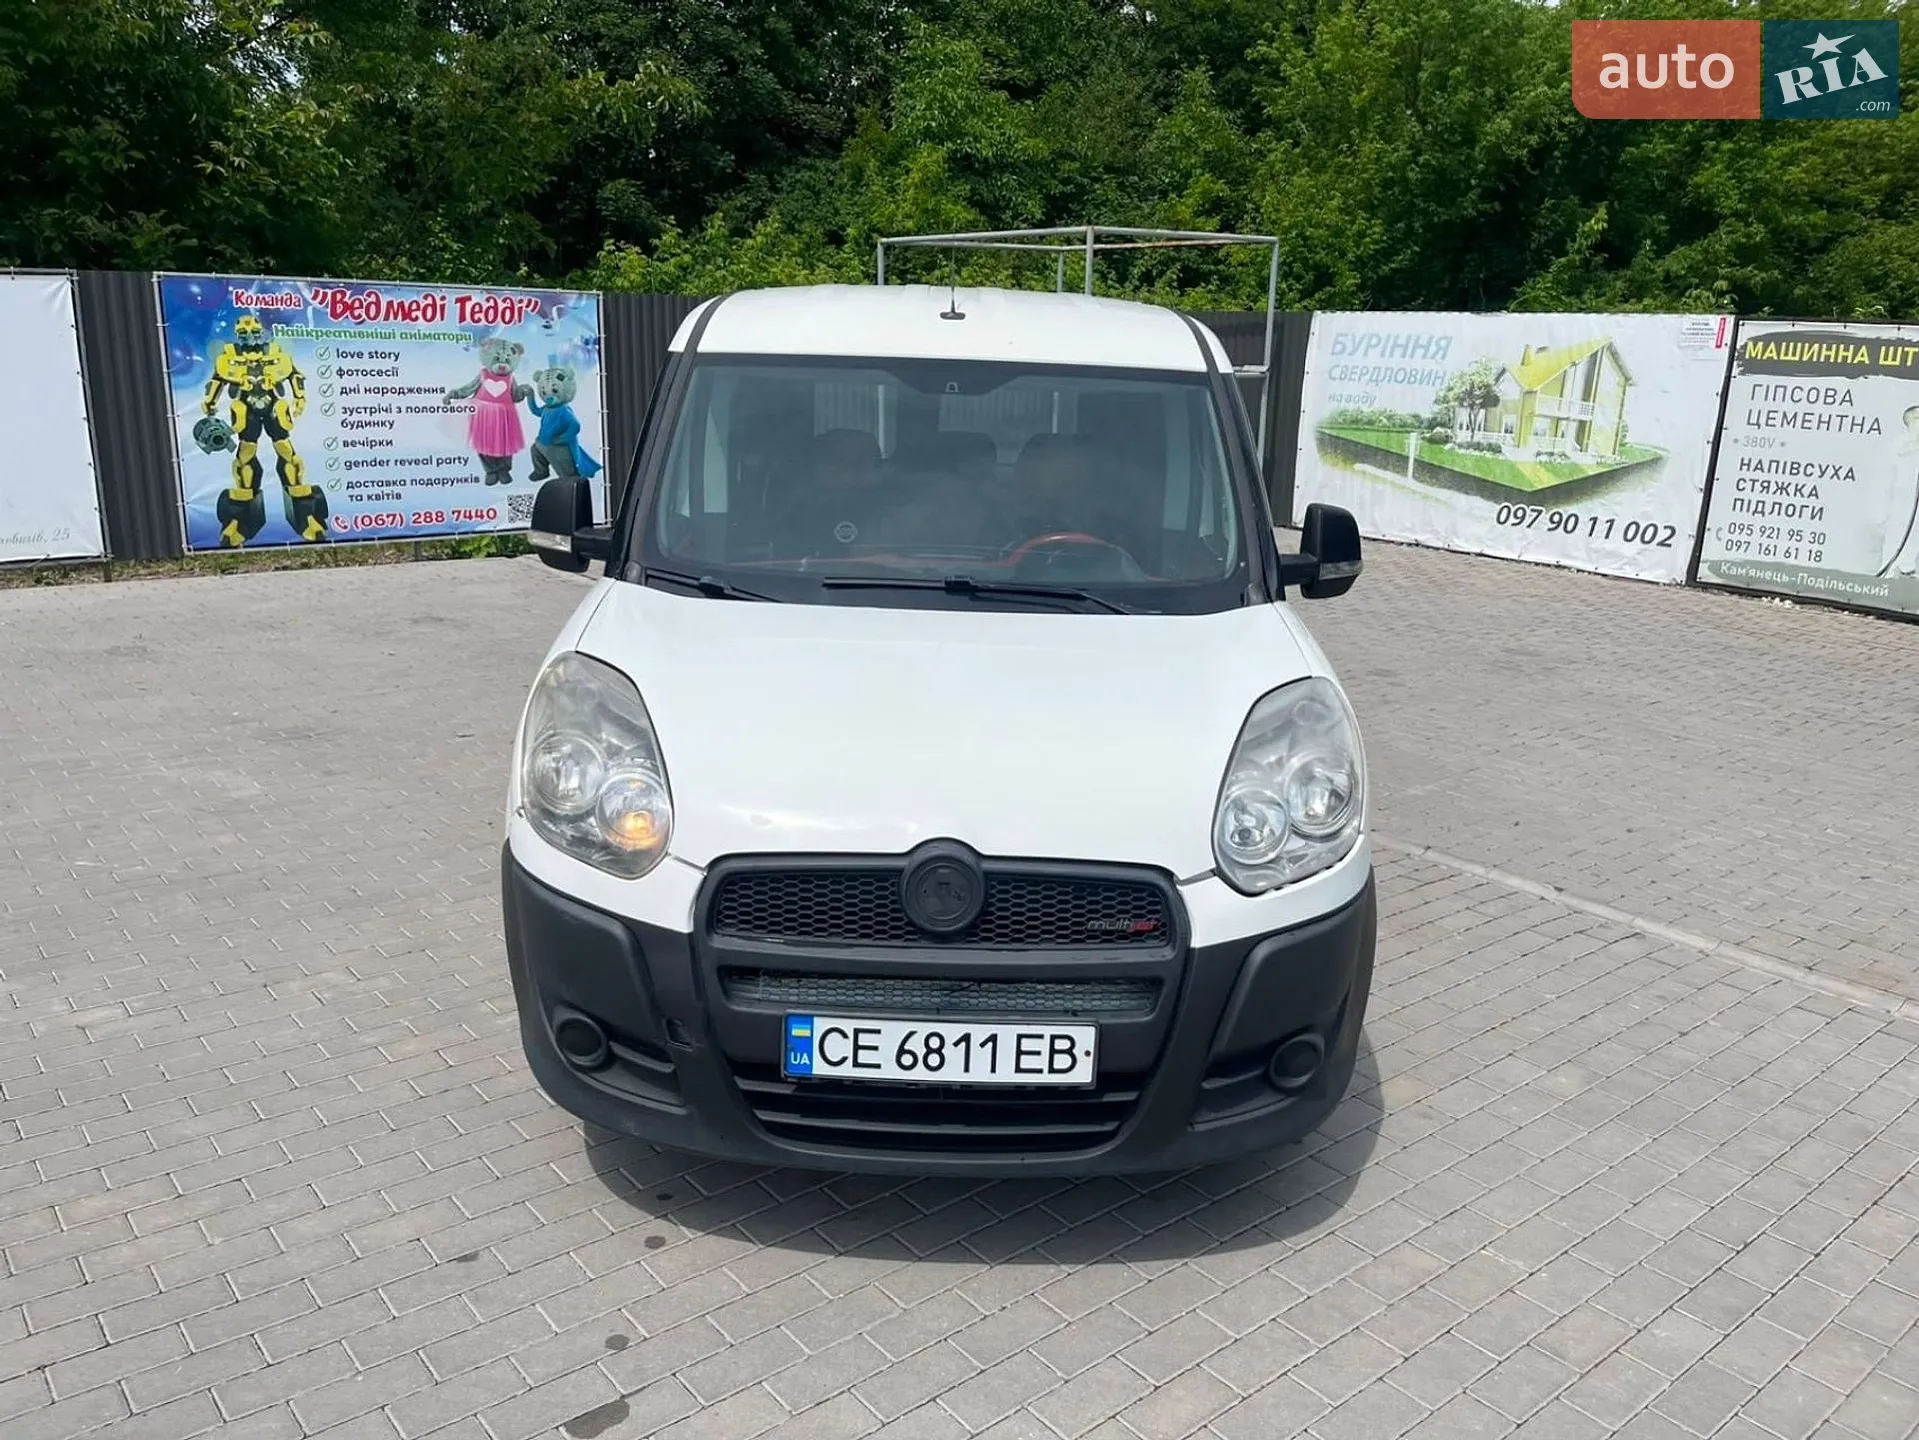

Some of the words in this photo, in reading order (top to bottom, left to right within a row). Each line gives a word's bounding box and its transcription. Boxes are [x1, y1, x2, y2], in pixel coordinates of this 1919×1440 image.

[234, 290, 302, 308] Команда
[274, 324, 396, 341] Найкреативніші
[400, 329, 472, 342] аніматори
[336, 348, 364, 360] love
[367, 349, 400, 362] story
[1330, 333, 1453, 360] БУРІННЯ
[1744, 340, 1870, 365] МАШИННА
[336, 366, 400, 379] фотосесії
[1328, 364, 1448, 387] СВЕРДЛОВИН
[340, 384, 361, 396] дні
[364, 386, 446, 398] народження
[1750, 383, 1855, 407] ГІПСОВА
[341, 404, 393, 418] зустрічі
[405, 405, 476, 415] пологового
[1746, 408, 1882, 436] ЦЕМЕНТНА
[340, 418, 395, 431] будинку
[342, 437, 394, 450] вечірки
[344, 459, 391, 471] gender
[394, 456, 433, 469] reveal
[436, 455, 469, 469] party
[1738, 457, 1857, 482] НАПІВСУХА
[346, 480, 407, 491] доставка
[410, 474, 480, 487] подарунків
[1735, 478, 1820, 500] СТЯЖКА
[349, 494, 364, 503] та
[366, 491, 402, 502] квітів
[353, 513, 404, 530] (067)
[411, 511, 446, 526] 288
[452, 507, 498, 522] 7440
[1731, 497, 1825, 522] ПІДЛОГИ
[1495, 504, 1544, 529] 097
[1547, 510, 1580, 535] 90
[1587, 516, 1616, 540] 11
[1622, 520, 1677, 548] 002
[1727, 522, 1755, 537] 095
[1758, 525, 1782, 540] 921
[1787, 529, 1804, 543] 95
[1808, 532, 1827, 546] 30
[1724, 538, 1752, 553] 097
[1758, 543, 1778, 557] 161
[1783, 546, 1800, 561] 61
[1808, 549, 1824, 563] 18
[1719, 562, 1890, 598] Кам'янець-Подільський
[790, 1052, 810, 1065] UA
[818, 1026, 882, 1069] CE
[895, 1030, 999, 1074] 6811
